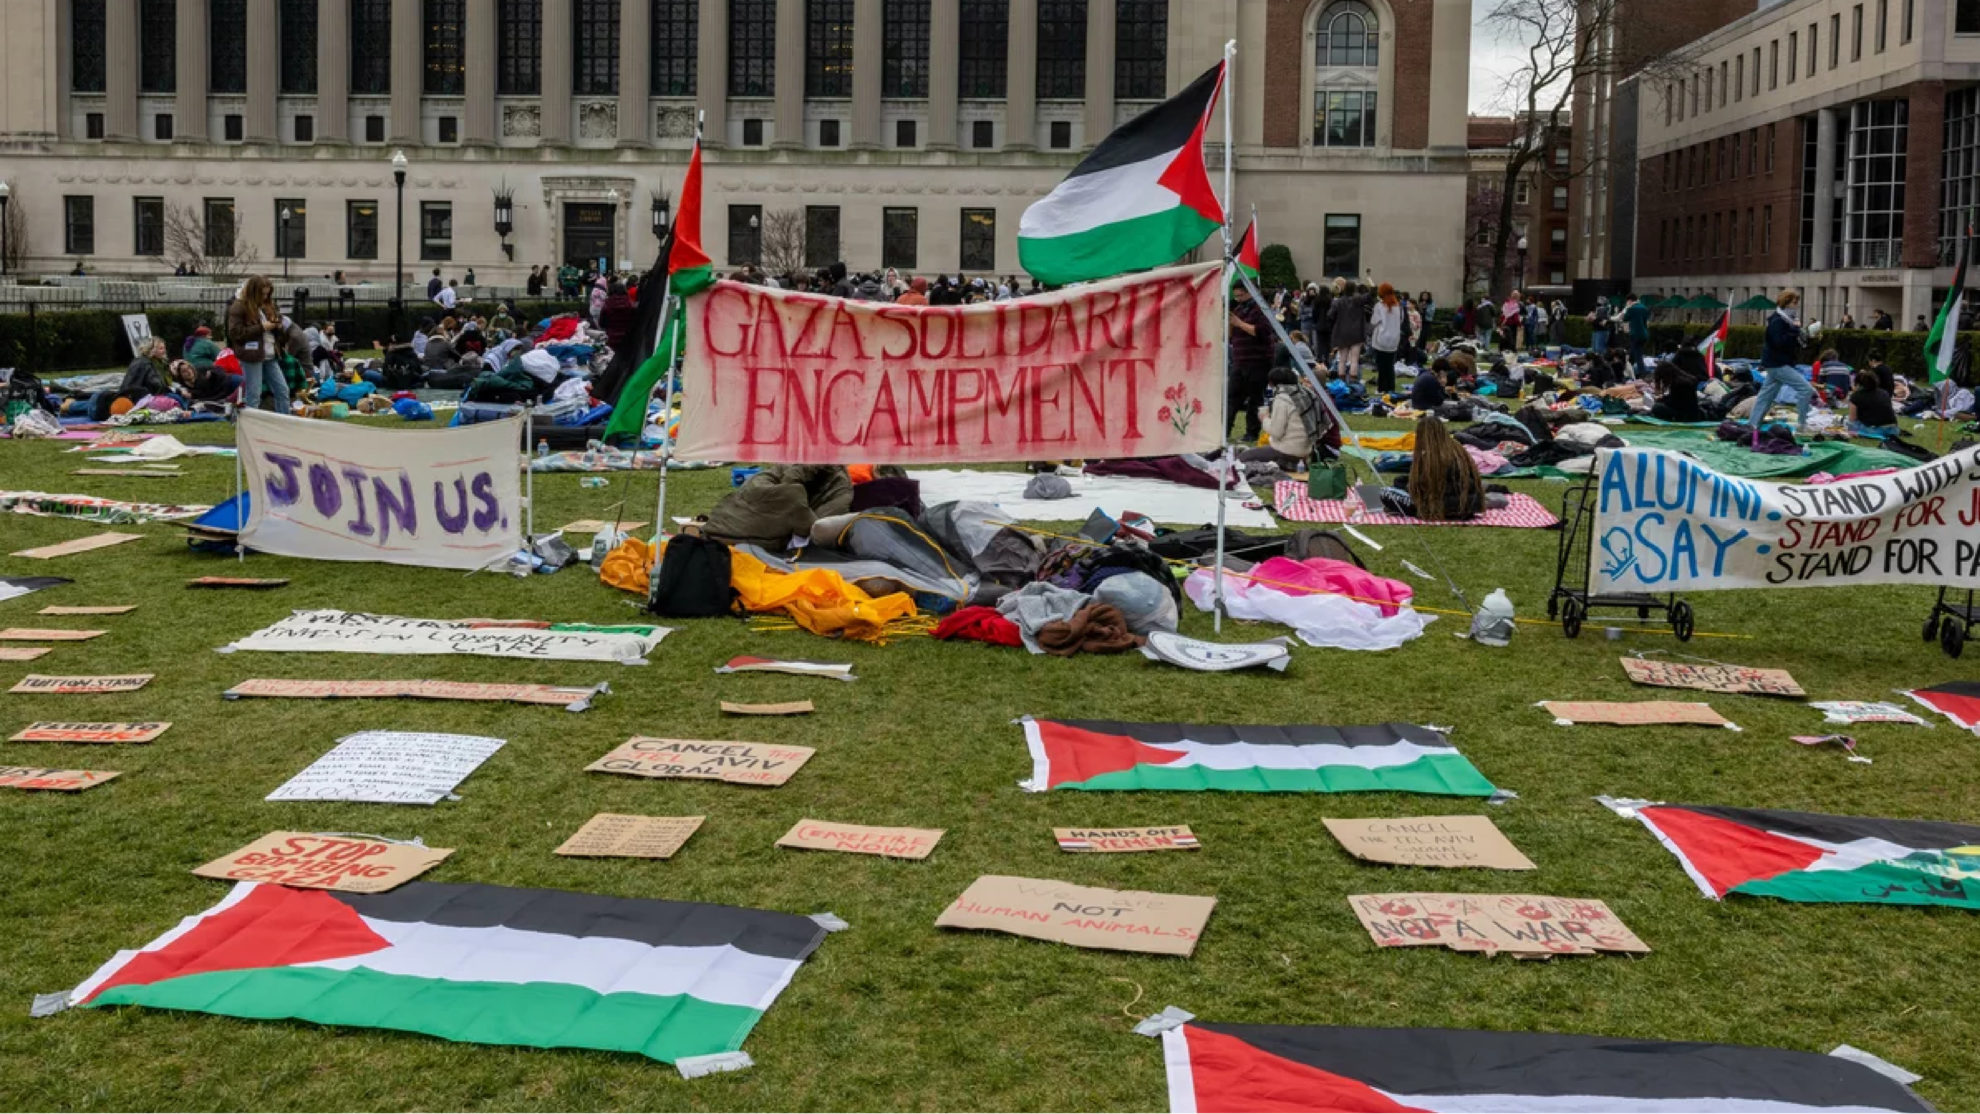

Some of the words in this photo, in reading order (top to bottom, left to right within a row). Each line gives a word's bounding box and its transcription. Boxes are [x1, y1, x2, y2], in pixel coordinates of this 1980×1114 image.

[703, 286, 873, 360] GAZA
[739, 357, 1154, 448] ENCAMPMENT
[264, 451, 418, 546] JOIN
[434, 470, 508, 535] US.
[1777, 482, 1887, 517] STAND
[1893, 457, 1963, 504] WITH
[1778, 517, 1881, 550] STAND
[1893, 495, 1946, 533] FOR
[1765, 544, 1873, 584] STAND
[1883, 537, 1943, 576] FOR
[631, 740, 757, 758] CANCEL
[602, 758, 720, 775] GLOBAL
[700, 756, 785, 770] AVIV
[1070, 829, 1140, 838] HANDS
[1146, 827, 1181, 836] OFF
[1091, 836, 1174, 849] YEMEN
[272, 836, 388, 864] STOP
[226, 867, 343, 886] GAZA
[234, 852, 396, 878] BOMBING
[956, 896, 1051, 923] HUMAN
[1052, 901, 1136, 917] NOT
[1370, 917, 1438, 939] NOT
[1455, 918, 1487, 939] A
[1491, 919, 1604, 947] WAR
